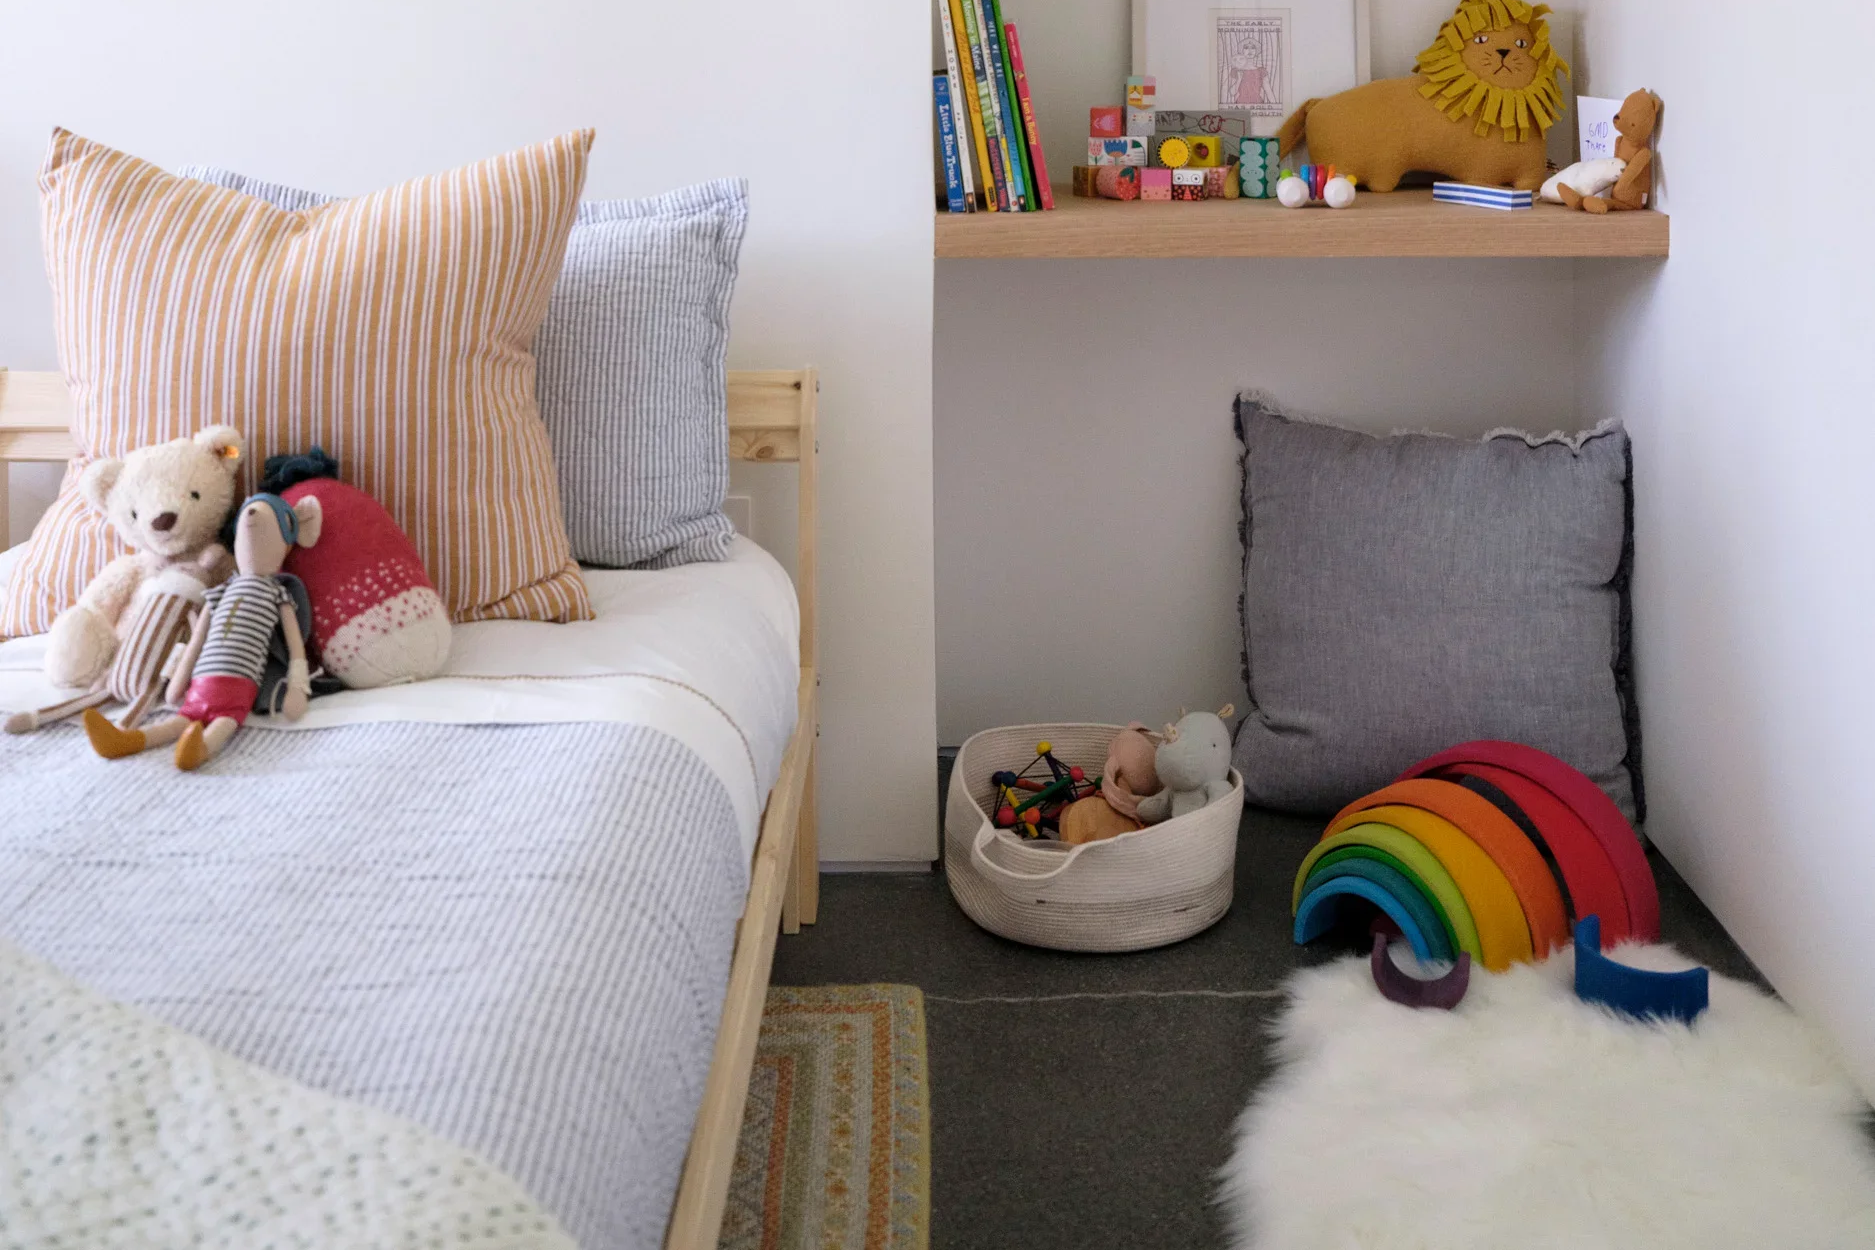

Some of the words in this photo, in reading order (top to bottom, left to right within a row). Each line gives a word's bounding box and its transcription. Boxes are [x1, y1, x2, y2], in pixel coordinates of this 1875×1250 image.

[962, 0, 976, 33] Morning
[970, 45, 983, 70] Maine
[991, 43, 999, 54] WE
[947, 48, 957, 88] HOUSE
[938, 103, 953, 132] Little
[941, 133, 956, 155] Blue
[1025, 121, 1038, 145] Bunny
[944, 155, 960, 189] Truck
